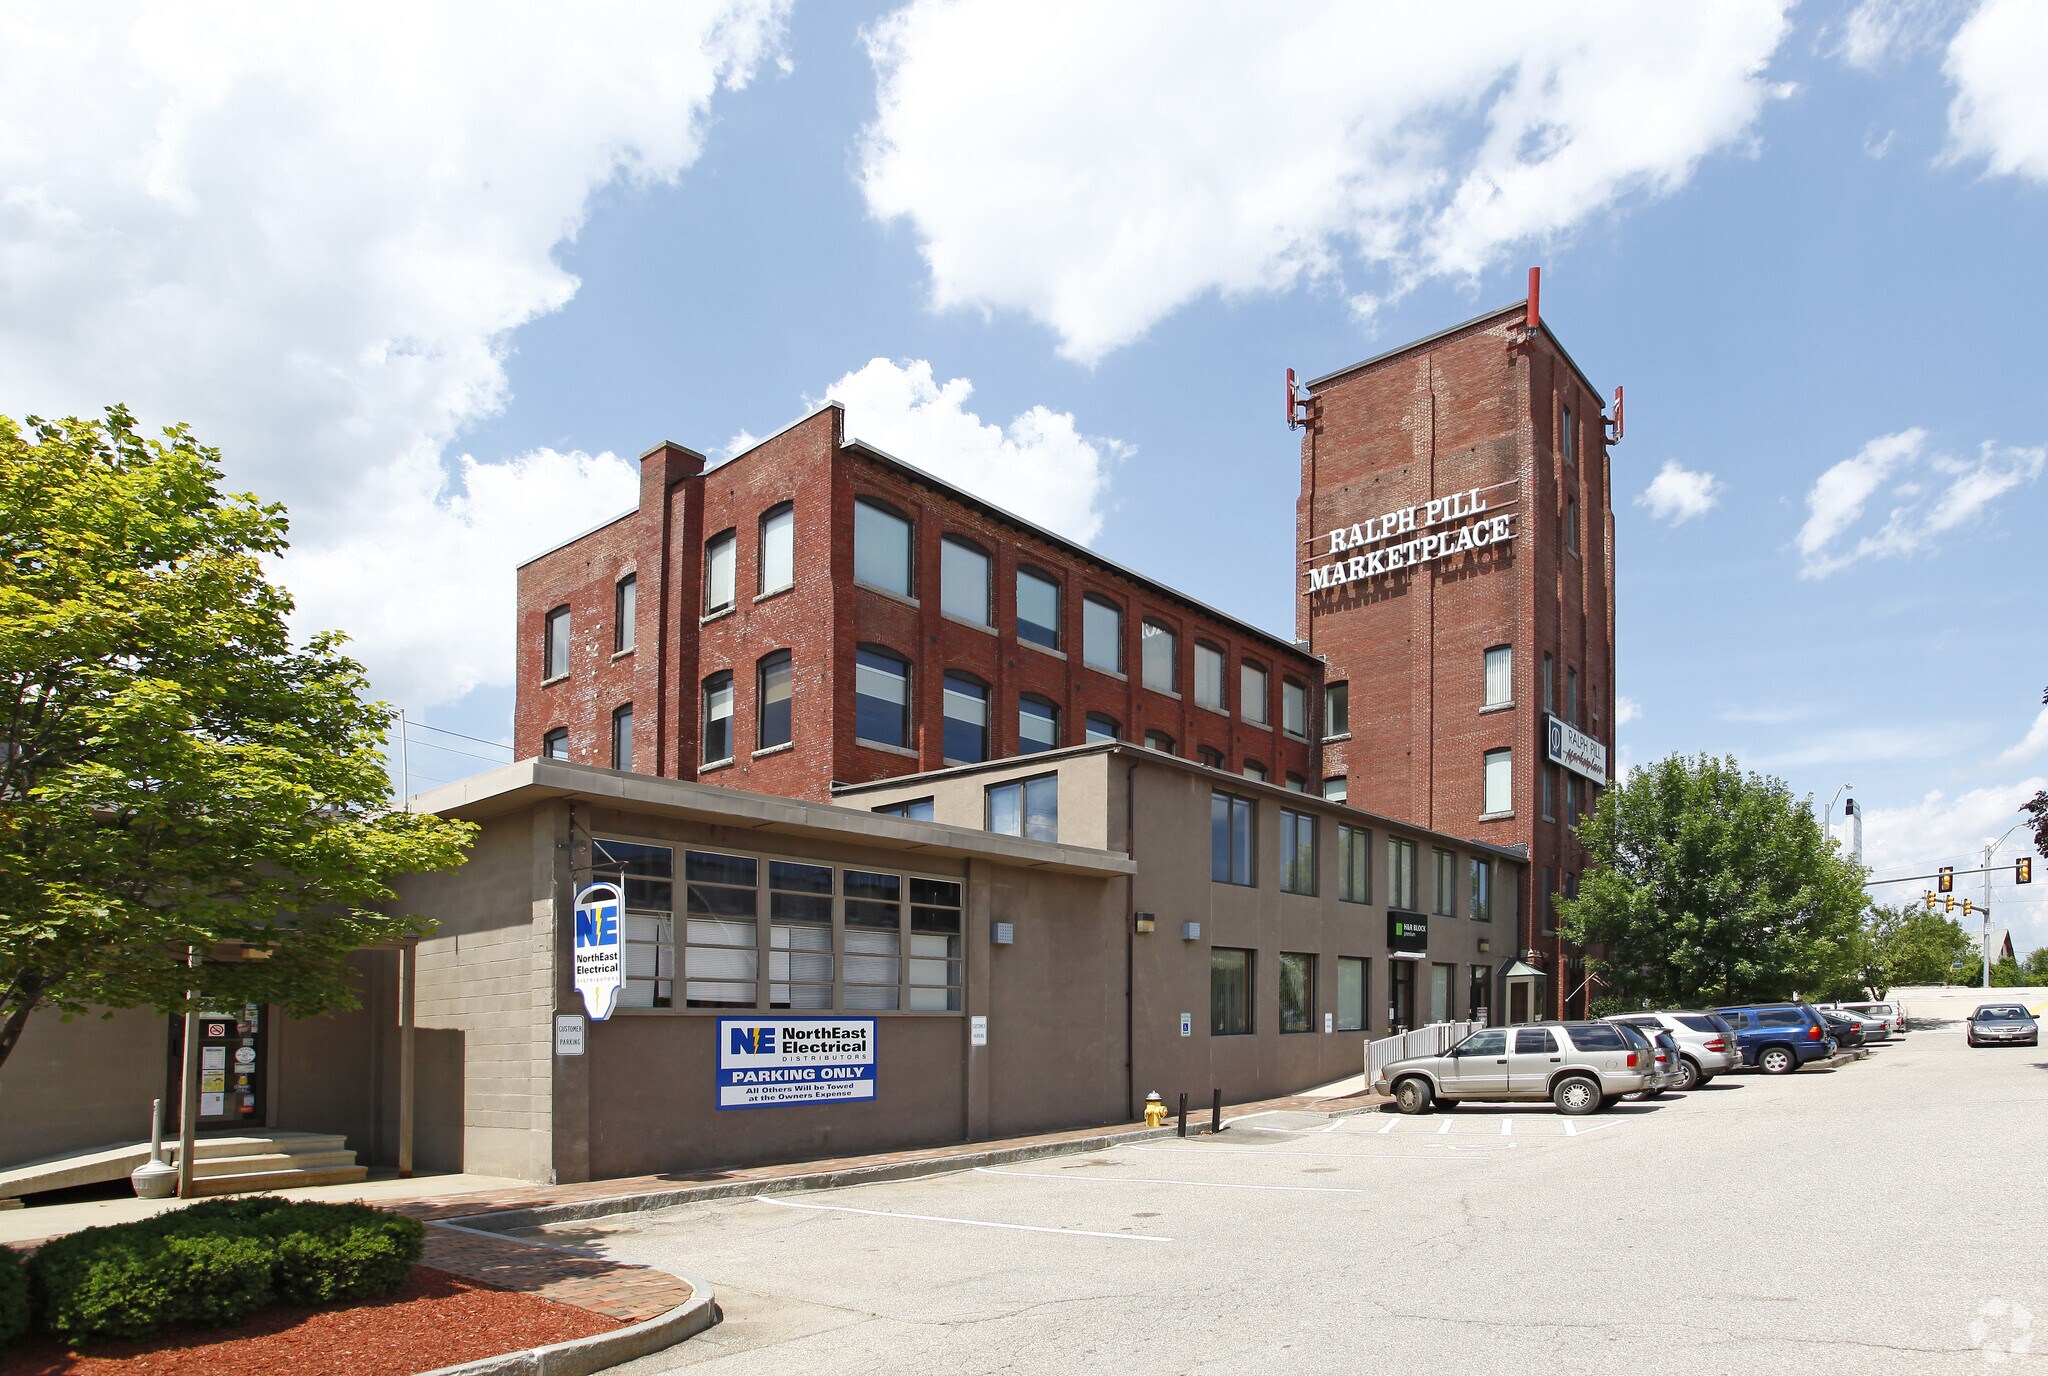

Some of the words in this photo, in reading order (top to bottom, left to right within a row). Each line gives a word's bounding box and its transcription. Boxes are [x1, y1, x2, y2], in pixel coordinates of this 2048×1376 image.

[1328, 505, 1416, 554] RALPH
[1425, 487, 1487, 526] PILL
[1308, 513, 1511, 592] MARKETPLACE
[1568, 729, 1588, 752] RALPH
[1590, 742, 1601, 760] PILL
[576, 952, 618, 963] NorthEast
[576, 963, 619, 975] Electrical
[558, 1025, 583, 1033] CUSTOMER
[782, 1027, 867, 1040] NorthEast
[559, 1038, 581, 1046] PARKING
[782, 1040, 867, 1054] Electrical
[782, 1053, 867, 1063] DISTRIBUTORS
[732, 1068, 816, 1084] PARKING
[820, 1066, 865, 1079] ONLY
[745, 1087, 760, 1095] All
[761, 1086, 793, 1095] Others
[794, 1084, 812, 1093] Will
[813, 1083, 826, 1092] be
[826, 1082, 854, 1091] Towed
[778, 1093, 814, 1101] Owners
[815, 1090, 853, 1100] Expense
